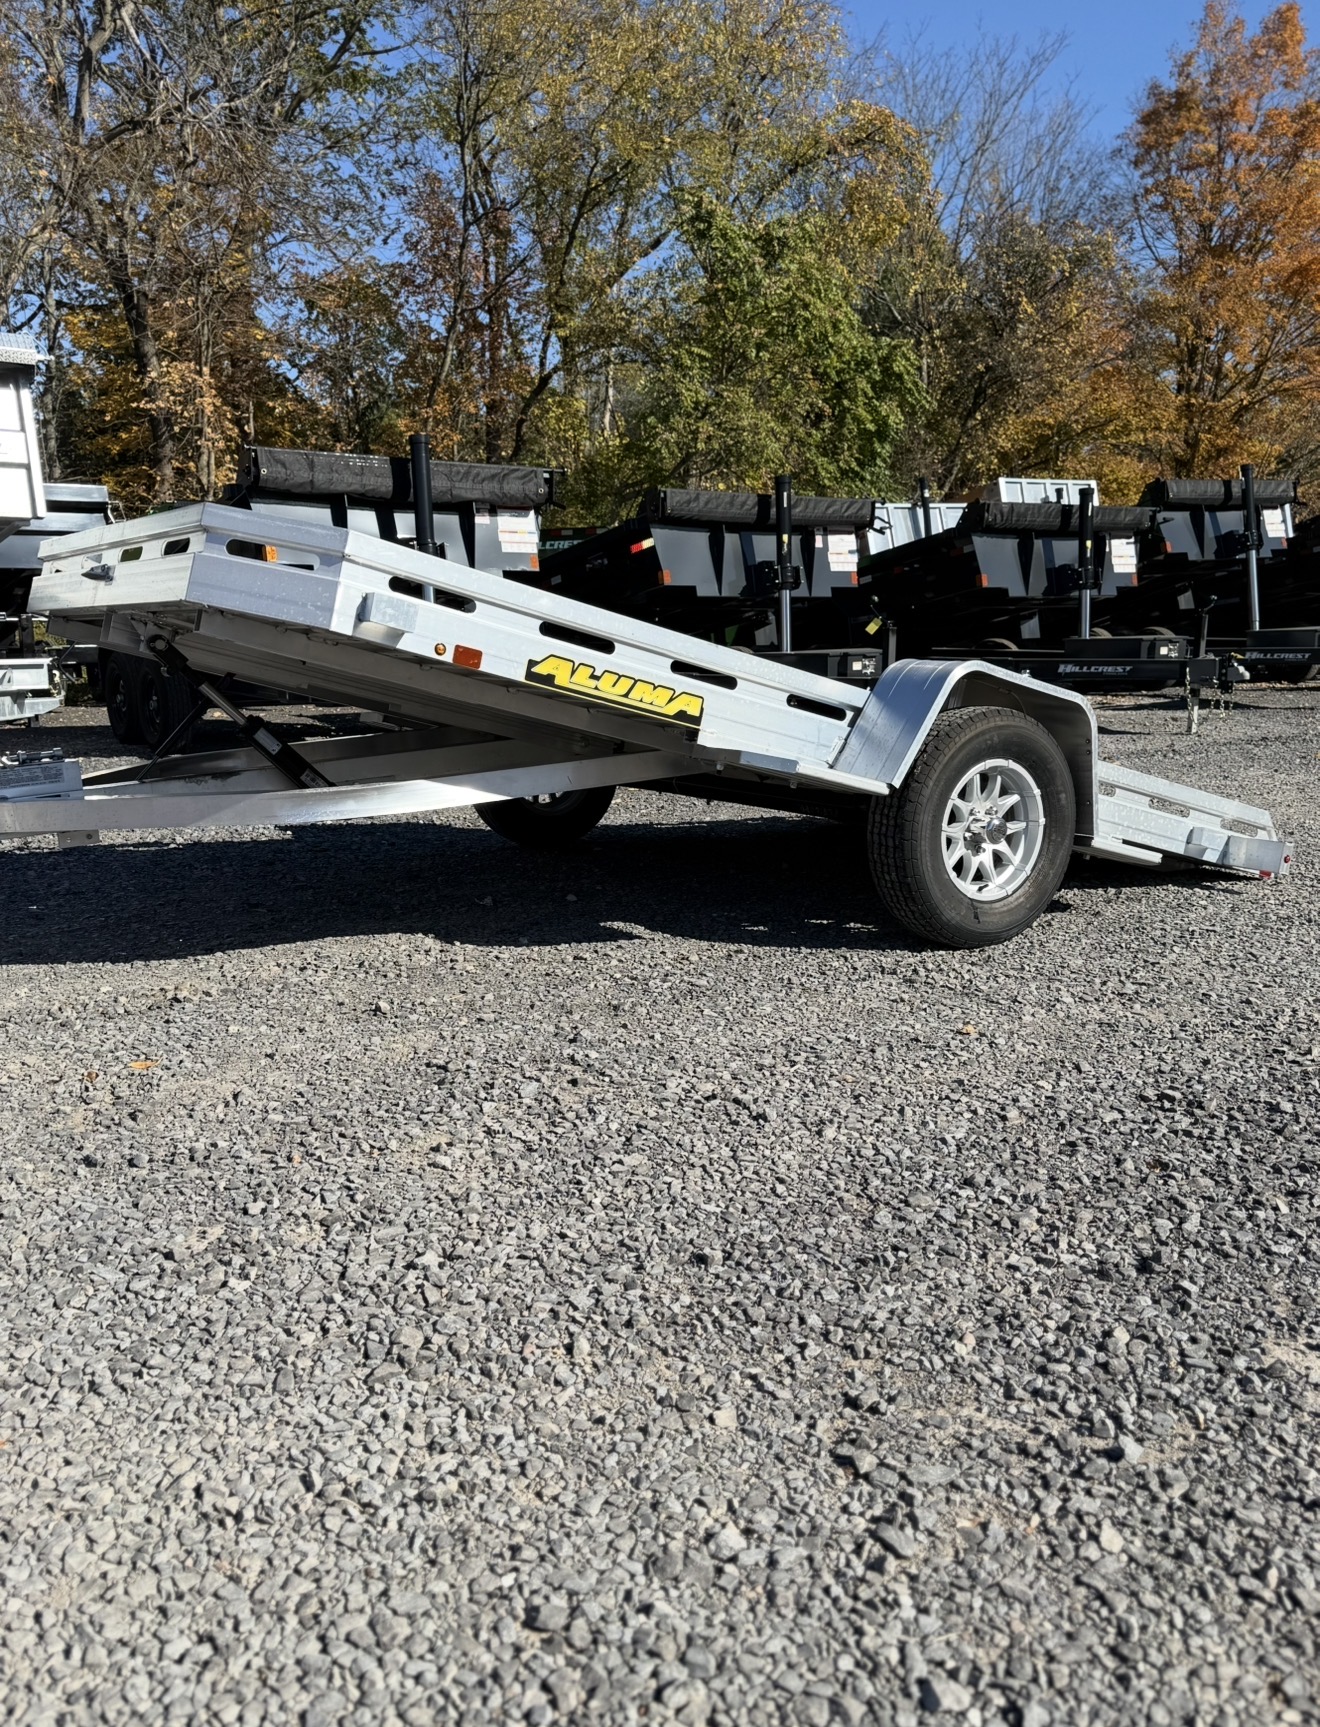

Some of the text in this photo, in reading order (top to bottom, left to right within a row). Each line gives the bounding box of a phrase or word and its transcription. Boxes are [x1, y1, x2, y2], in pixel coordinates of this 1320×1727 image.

[1245, 651, 1312, 660] HILLCREST
[1057, 663, 1133, 674] HILLCREST
[529, 655, 704, 717] ALUMA
